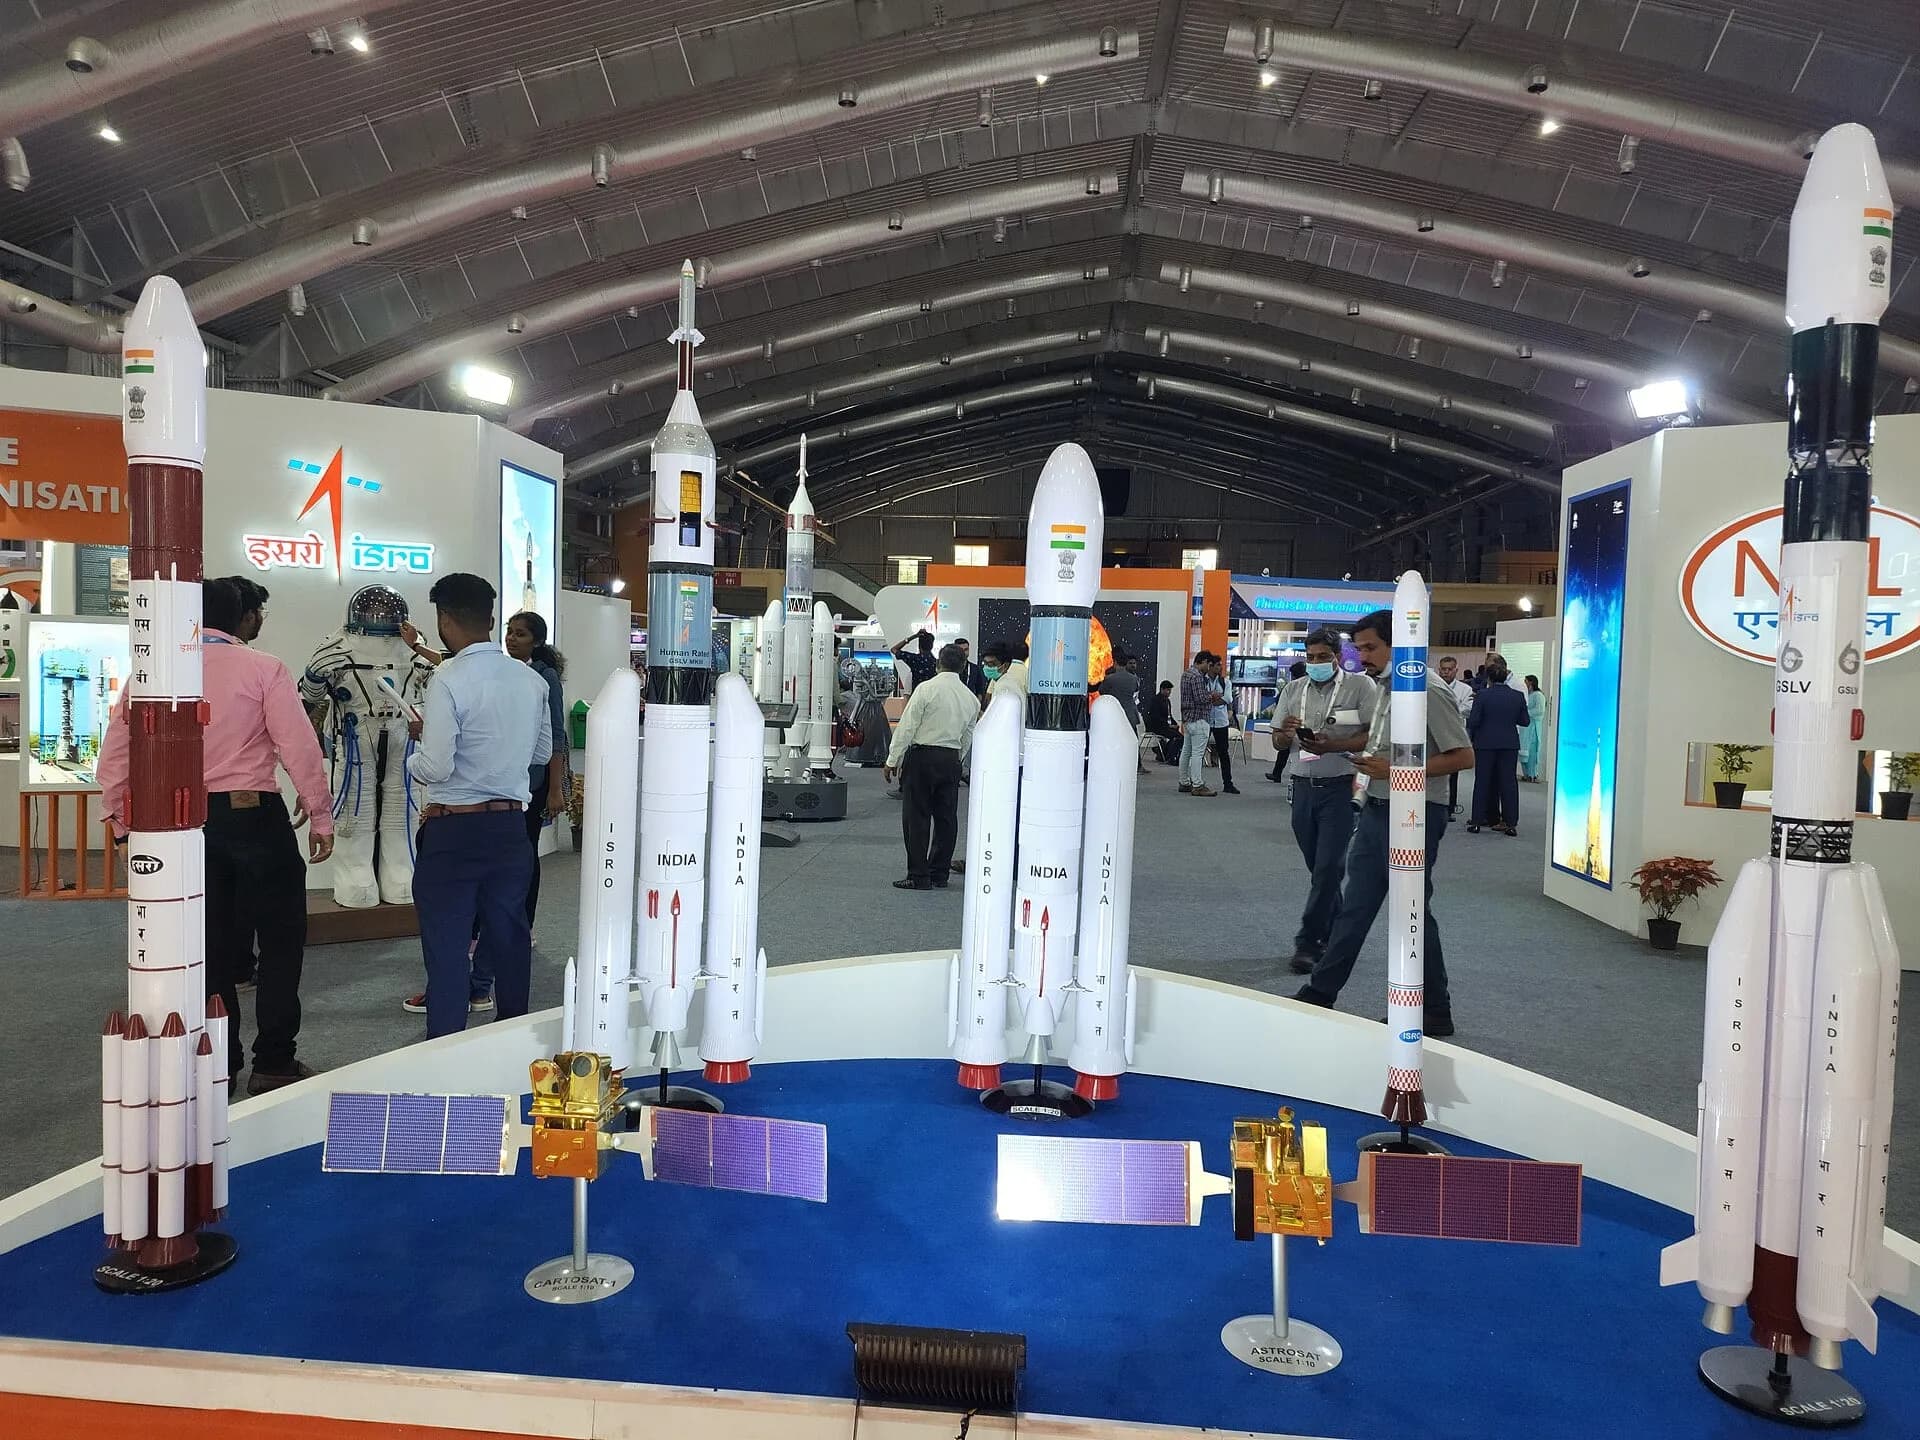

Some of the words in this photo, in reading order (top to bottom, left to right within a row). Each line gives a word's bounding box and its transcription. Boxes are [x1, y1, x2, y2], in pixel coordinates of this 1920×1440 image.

[247, 533, 324, 566] इसरो
[659, 648, 690, 657] Human
[1400, 665, 1424, 675] SSLV
[1038, 680, 1060, 688] GSLV
[1776, 680, 1811, 694] GSLV
[603, 822, 615, 889] ISRO
[657, 853, 697, 867] INDIA
[734, 822, 745, 886] INDIA
[983, 832, 993, 895] ISRO
[1030, 864, 1068, 880] INDIA
[1099, 842, 1111, 905] INDIA
[1409, 899, 1418, 960] INDIA
[1731, 977, 1743, 1053] ISRO
[1825, 994, 1837, 1073] INDIA
[97, 1265, 137, 1280] SCALE
[136, 1275, 164, 1287] 1:20
[1250, 1347, 1321, 1361] ASTROSAT
[1259, 1356, 1293, 1364] SCALE
[1296, 1359, 1315, 1368] 1:10
[1780, 1400, 1833, 1416] SCALE
[1831, 1397, 1862, 1409] 1:20
